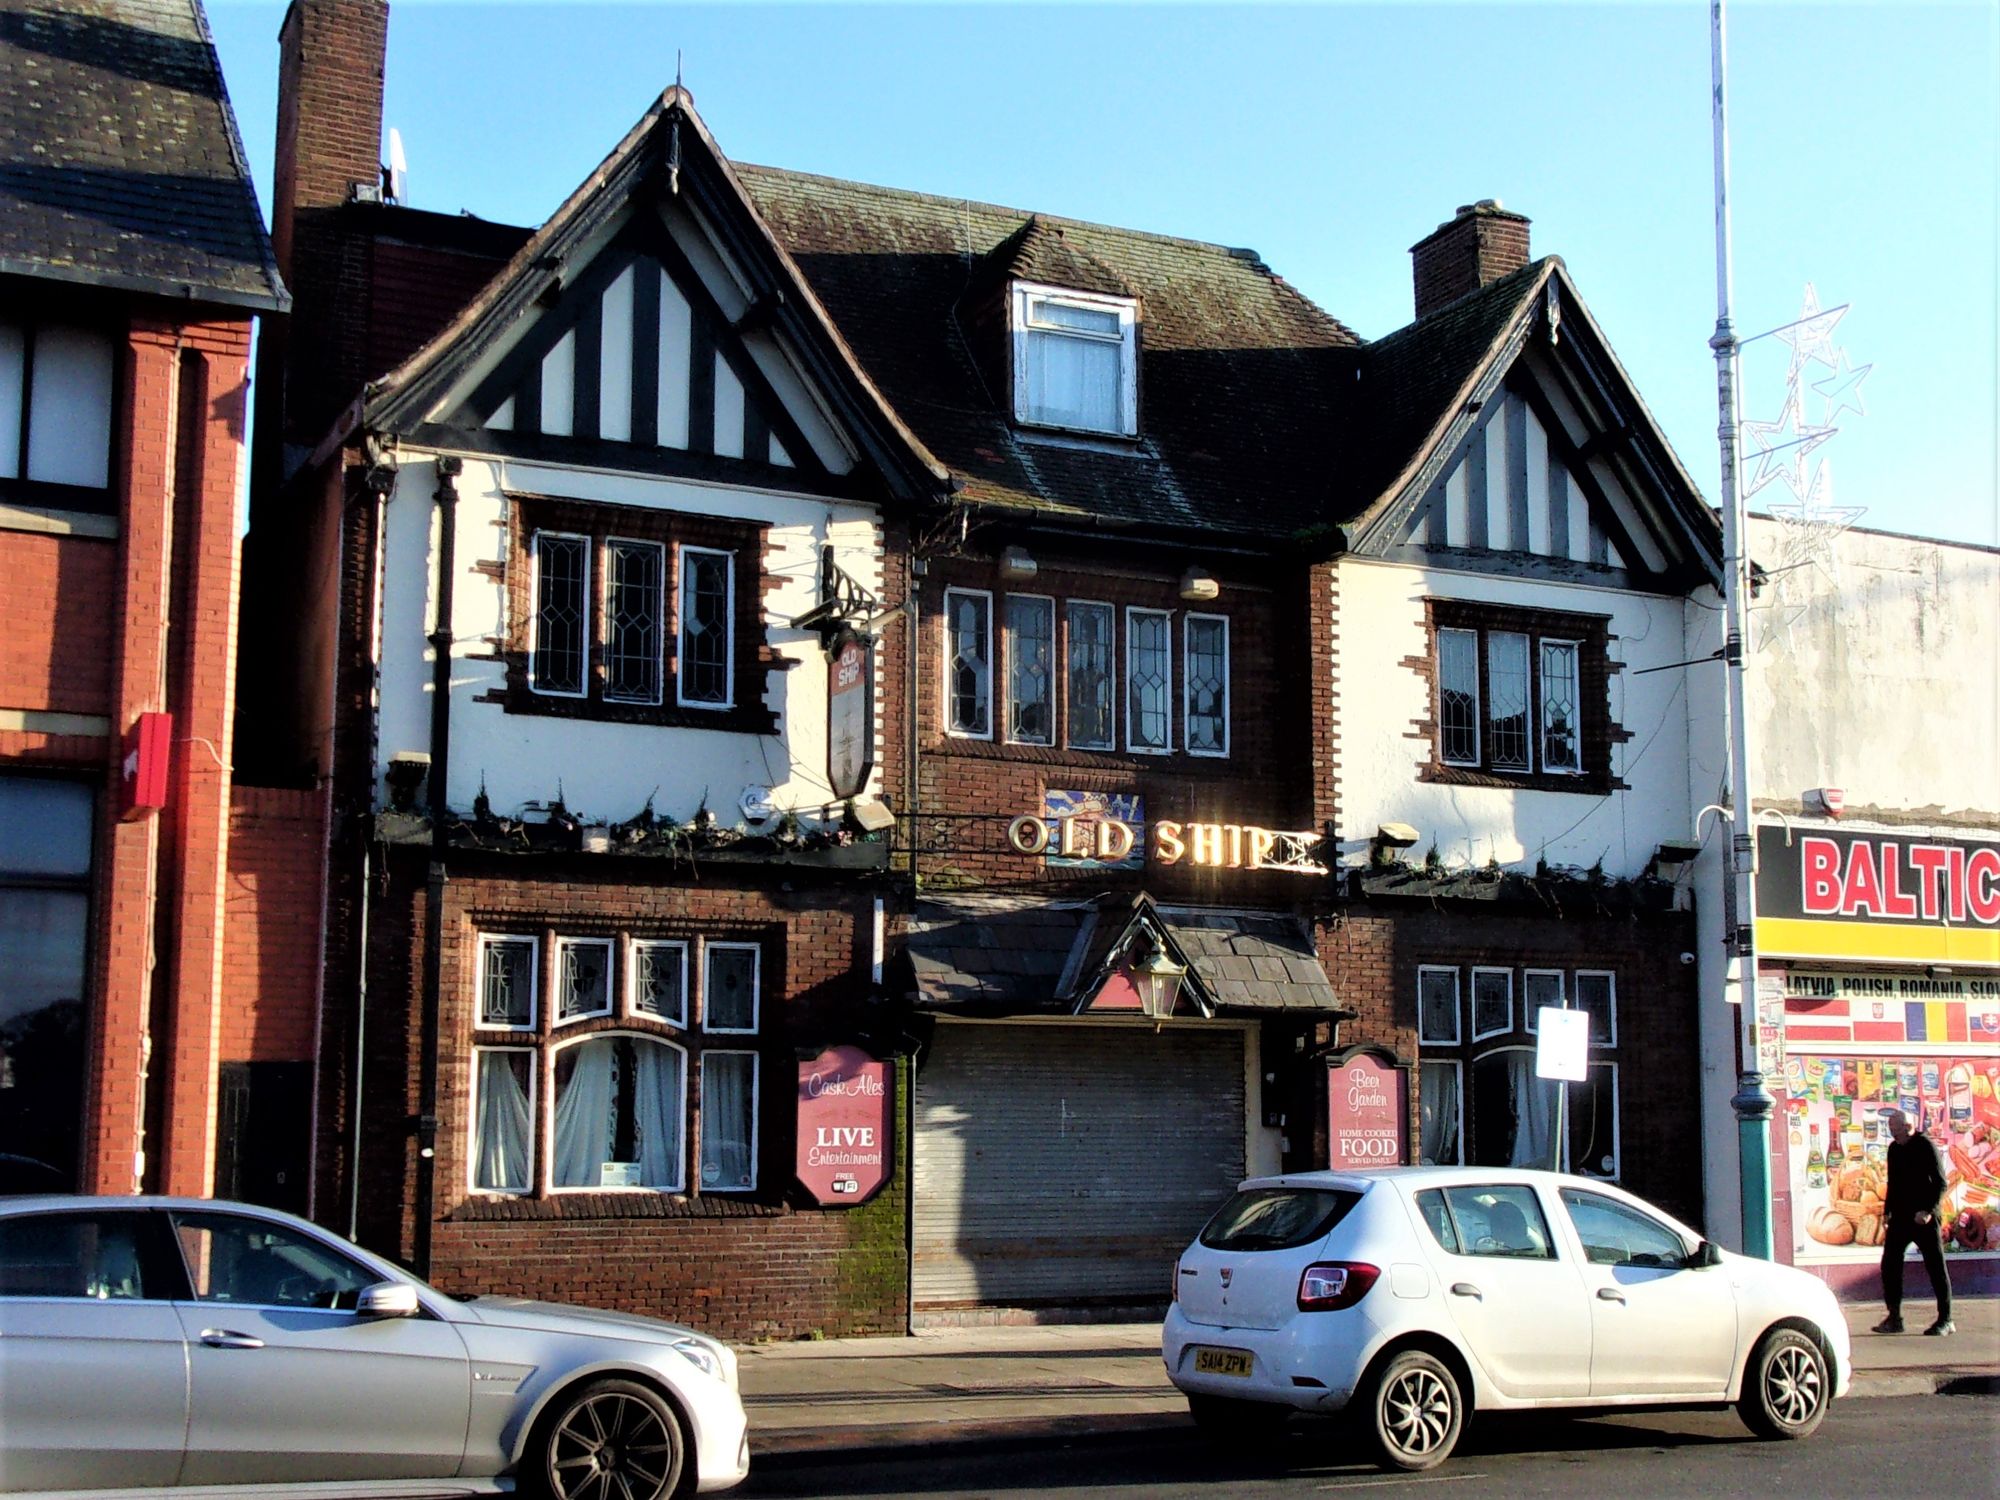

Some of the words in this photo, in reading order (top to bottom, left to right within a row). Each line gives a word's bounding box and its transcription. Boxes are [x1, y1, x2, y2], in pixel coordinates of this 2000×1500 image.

[841, 650, 857, 667] OLD
[838, 663, 860, 687] SHIP
[1008, 814, 1135, 860] OLD
[1156, 820, 1274, 870] SHIP
[1801, 836, 2000, 924] BALTIC
[808, 1073, 845, 1097] Cask
[846, 1074, 885, 1097] Ales
[1349, 1068, 1380, 1088] Beer
[1348, 1087, 1388, 1112] Garden
[816, 1127, 875, 1147] LIVE
[1339, 1129, 1363, 1137] HOME
[1364, 1129, 1398, 1137] COOKED
[808, 1146, 882, 1167] Entertainment
[1340, 1138, 1397, 1157] FOOD
[835, 1172, 855, 1180] FREE
